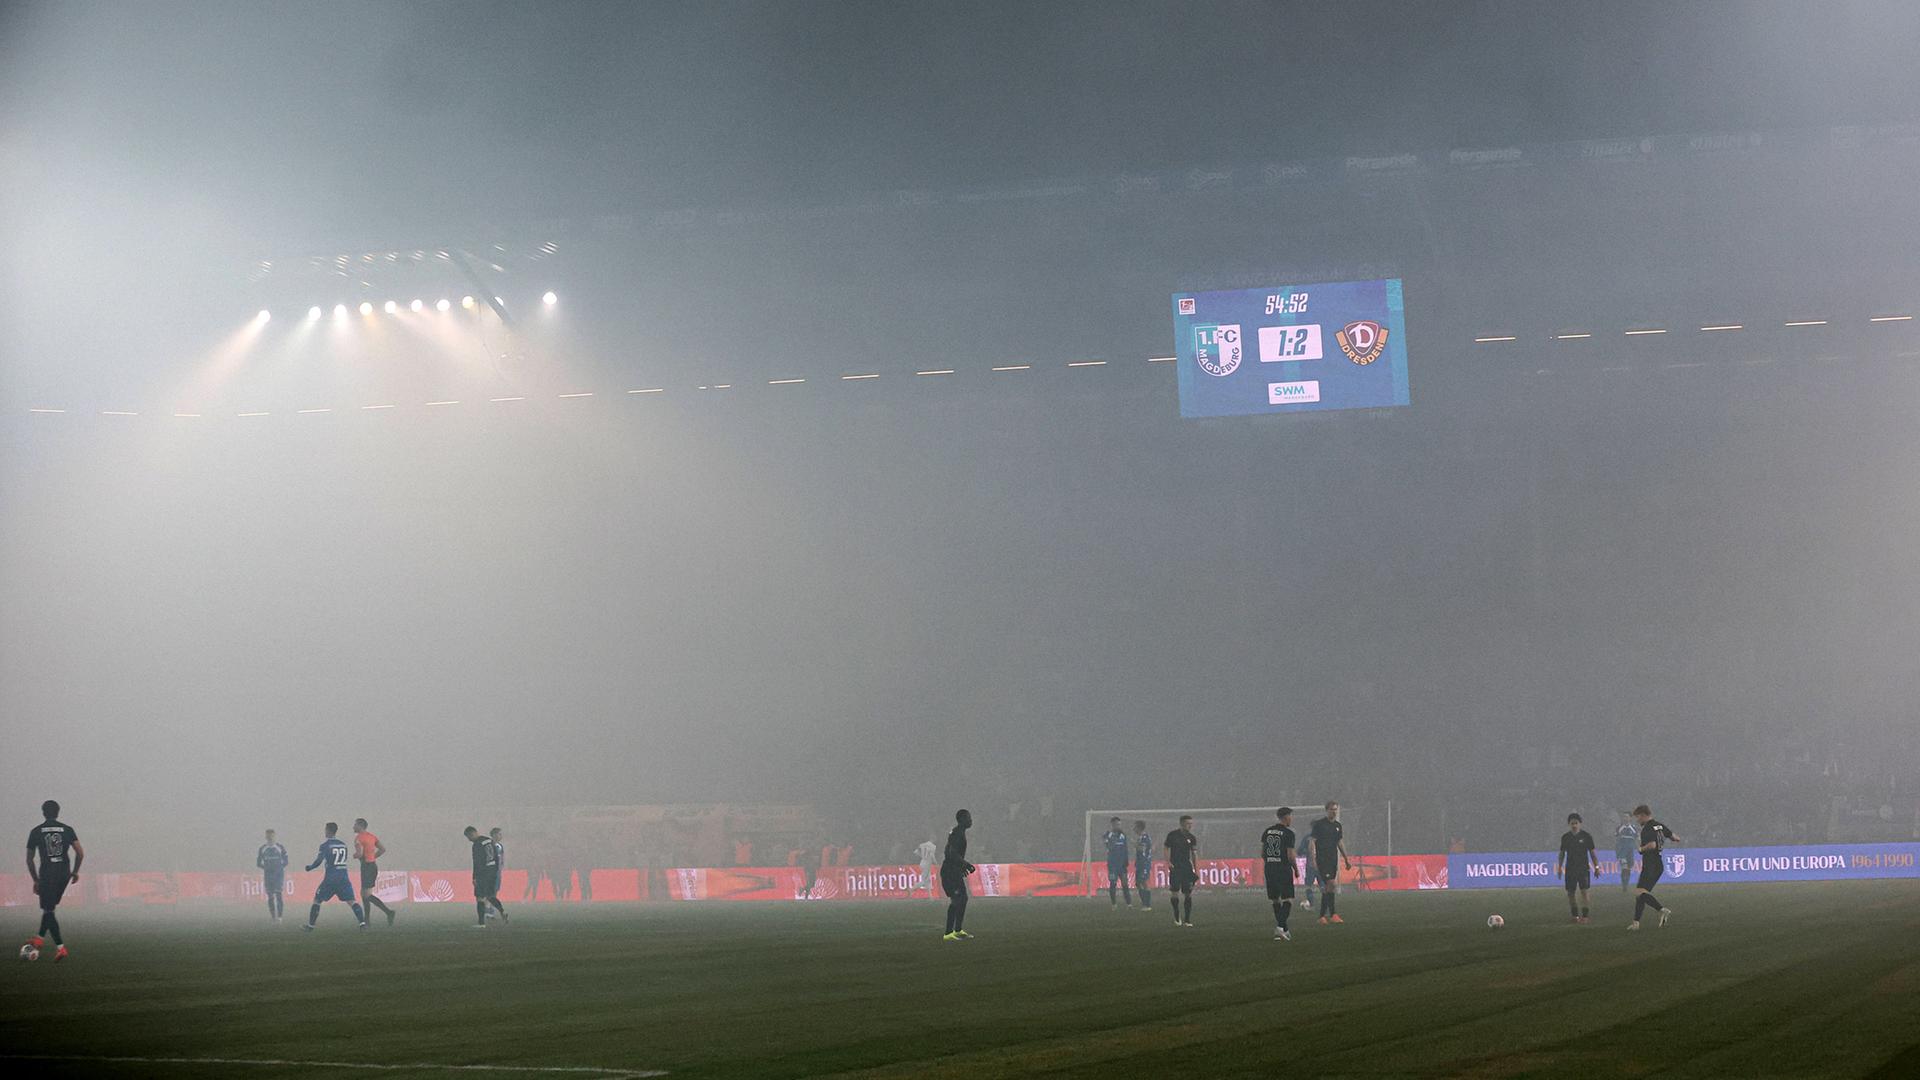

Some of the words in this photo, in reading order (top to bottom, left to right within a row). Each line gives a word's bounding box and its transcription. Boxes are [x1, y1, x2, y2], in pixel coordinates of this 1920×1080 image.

[1265, 293, 1308, 315] 54:52
[1278, 329, 1309, 357] 1:2
[1199, 346, 1240, 374] MAGDEBURG
[1341, 342, 1386, 366] DRESDEN
[1274, 385, 1306, 396] SWM
[332, 848, 348, 866] 22
[1703, 857, 1730, 872] DER
[1732, 856, 1760, 871] FCM
[1762, 855, 1791, 871] UND
[1793, 854, 1846, 870] EUROPA
[1850, 854, 1880, 870] 1964
[1883, 852, 1914, 868] 1990
[1466, 862, 1549, 878] MAGDEBURG
